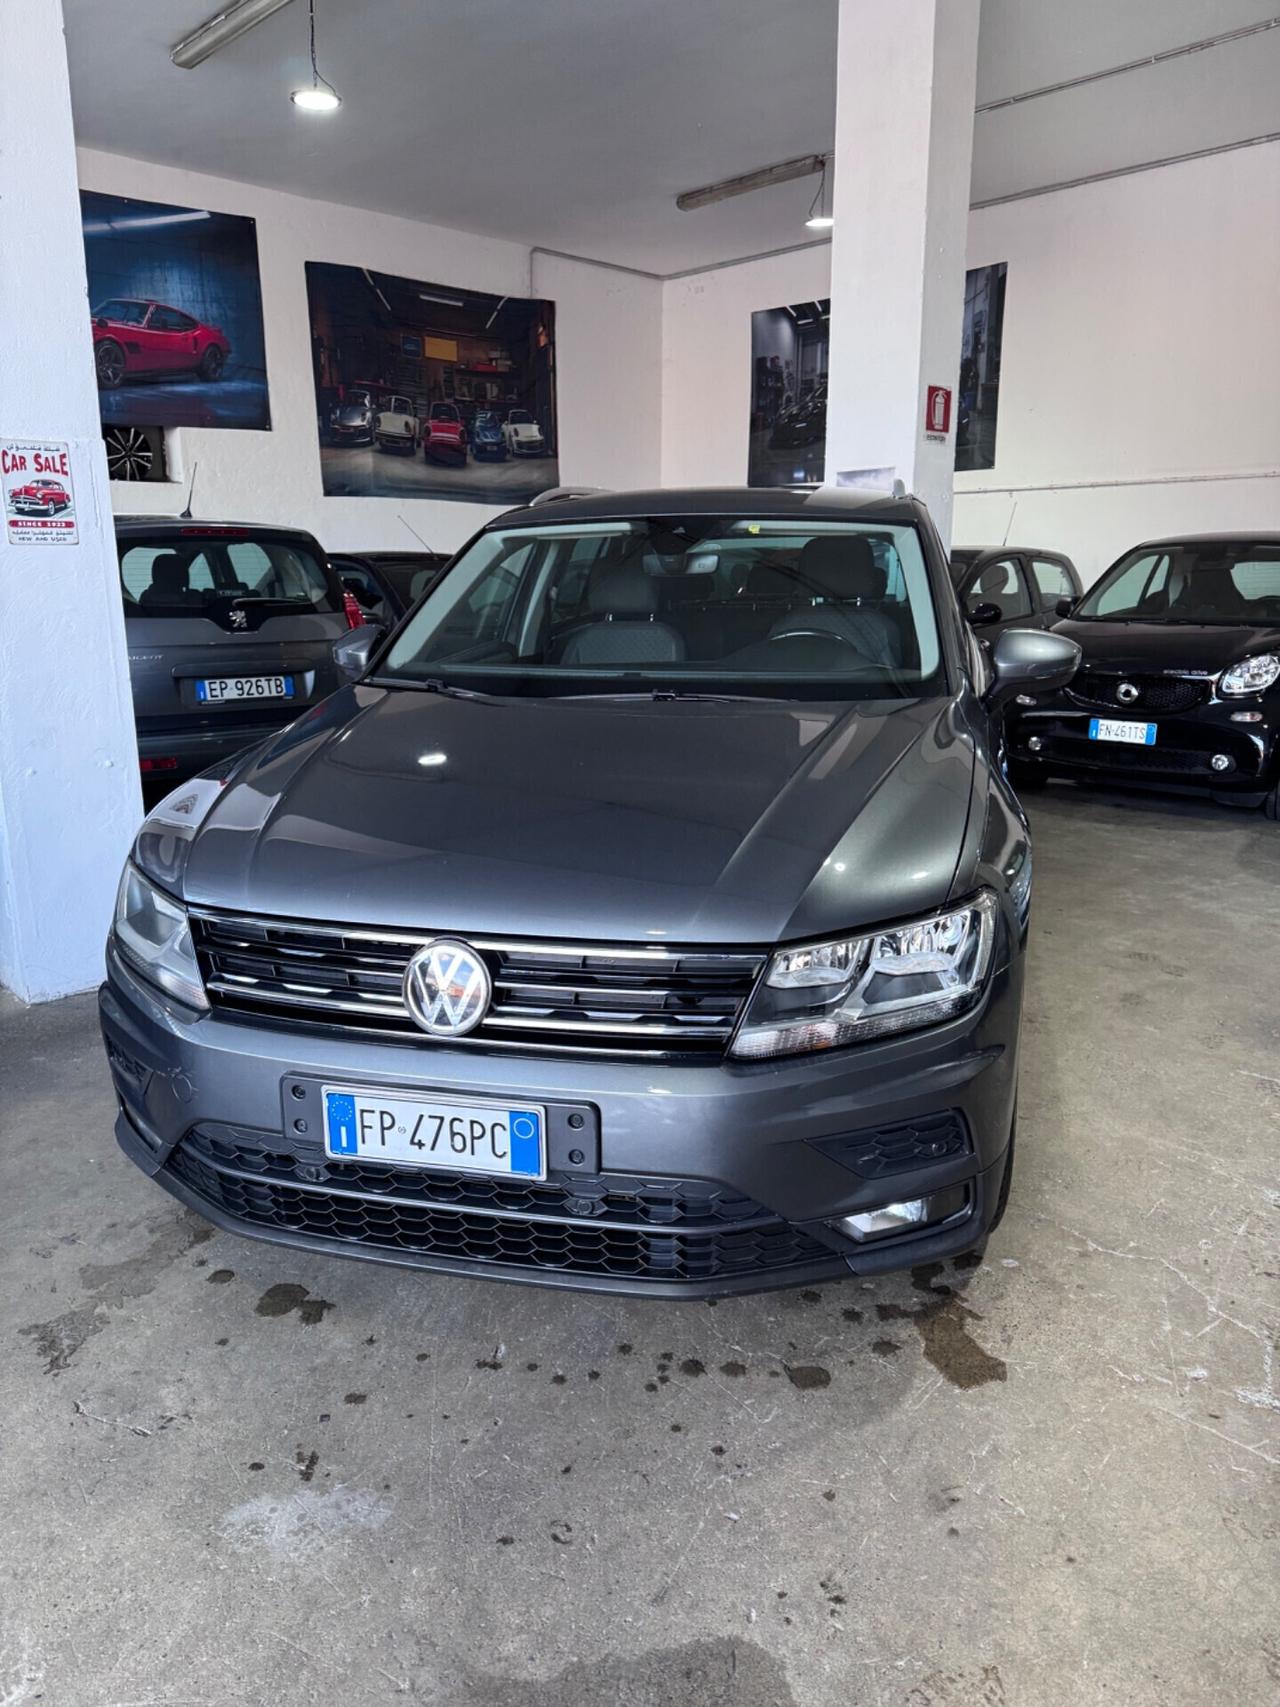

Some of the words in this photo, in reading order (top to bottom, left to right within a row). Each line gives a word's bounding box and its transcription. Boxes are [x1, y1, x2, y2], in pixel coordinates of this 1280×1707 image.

[1, 449, 27, 474] CAR
[33, 453, 69, 476] SALE
[208, 680, 228, 698] EP
[234, 678, 284, 697] 926TB
[359, 1108, 396, 1146] FP
[408, 1113, 508, 1159] 476PC
